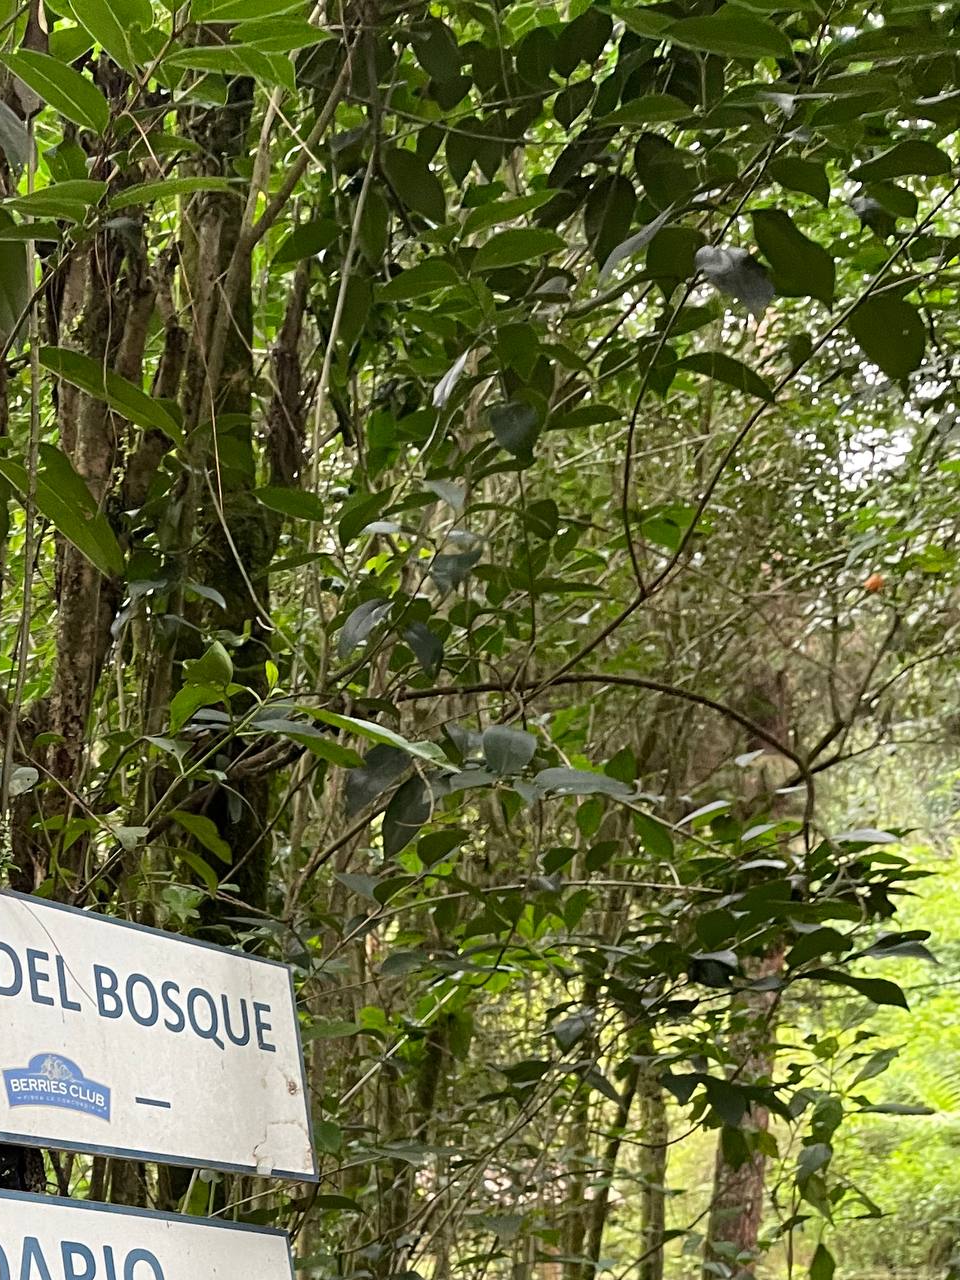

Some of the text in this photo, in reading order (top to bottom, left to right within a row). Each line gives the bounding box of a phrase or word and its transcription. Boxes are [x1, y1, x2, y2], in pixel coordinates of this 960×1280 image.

[93, 963, 277, 1052] BOSQUE
[10, 1078, 105, 1107] BERRIES CLUB
